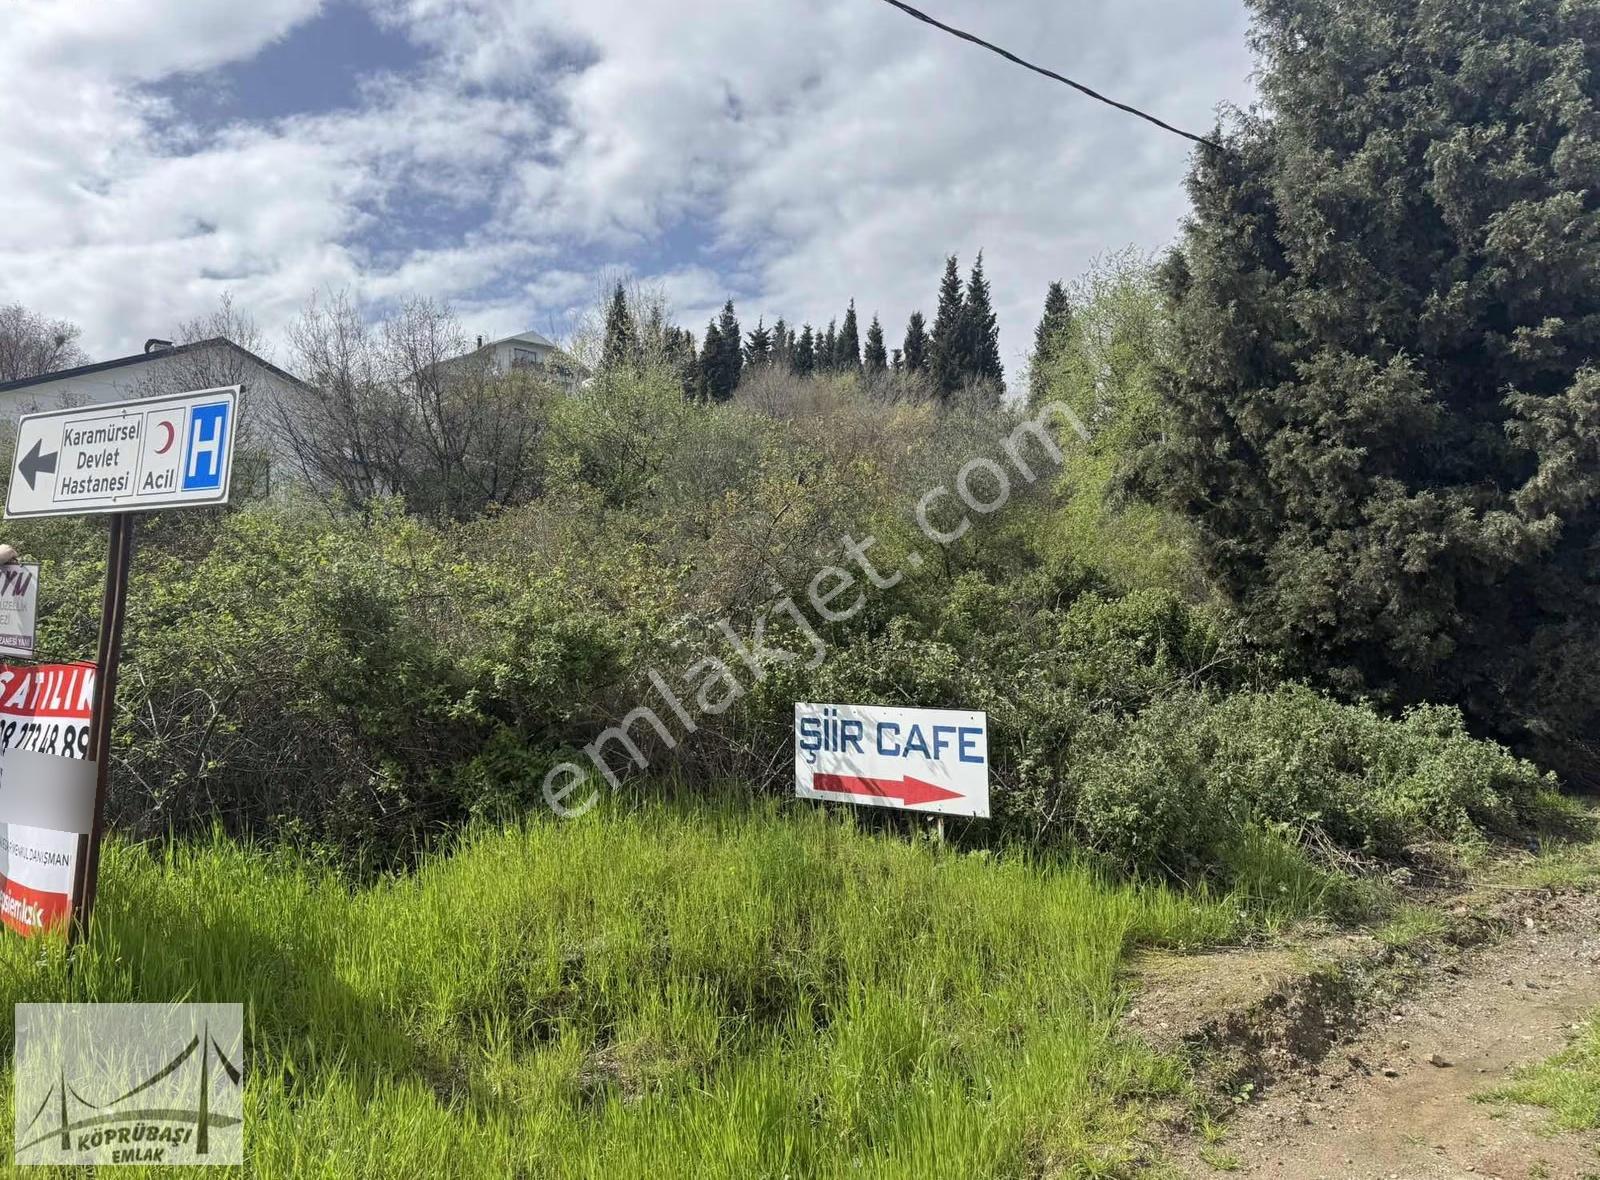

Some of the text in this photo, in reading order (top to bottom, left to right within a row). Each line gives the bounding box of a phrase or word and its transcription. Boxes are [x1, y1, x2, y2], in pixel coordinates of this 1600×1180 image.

[64, 420, 141, 447] Karamürsel
[188, 416, 222, 477] H
[77, 448, 120, 470] Devlet
[61, 471, 130, 496] Hastanesi
[142, 469, 175, 491] Acil
[876, 721, 985, 764] CAFE
